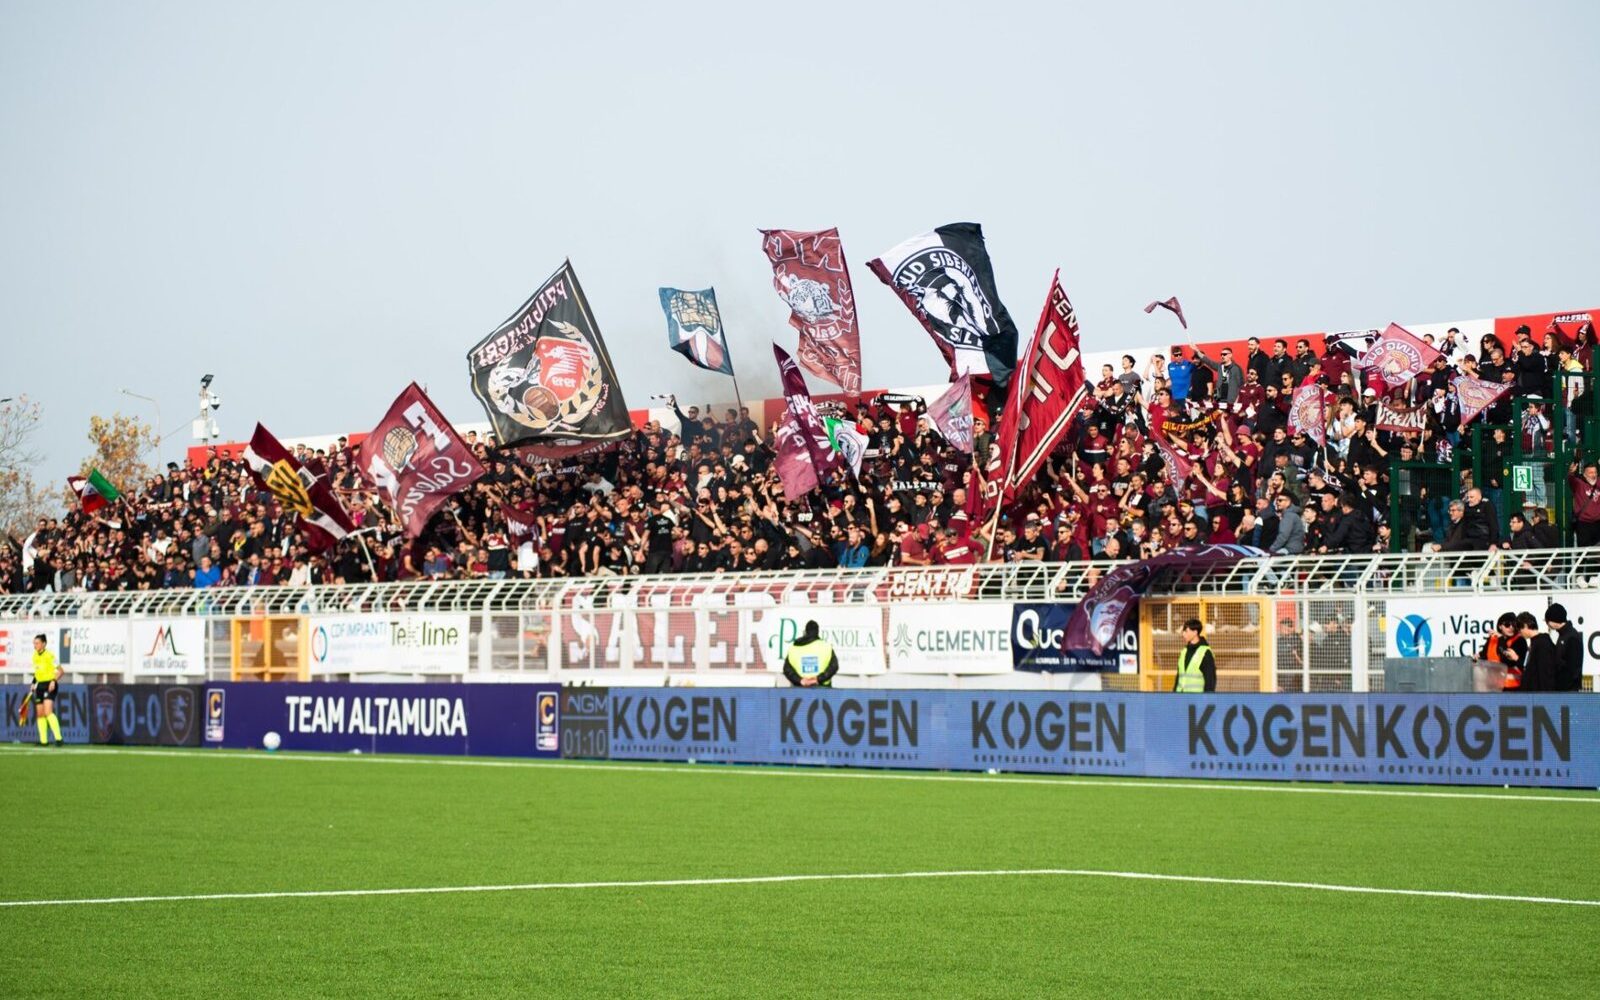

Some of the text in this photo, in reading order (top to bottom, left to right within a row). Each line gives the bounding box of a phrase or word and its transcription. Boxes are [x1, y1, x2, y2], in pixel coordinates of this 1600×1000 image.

[73, 627, 90, 639] BCC
[93, 643, 126, 656] MURGIA
[917, 630, 1008, 652] CLEMENTE
[286, 696, 468, 737] TEAM ALTAMURA
[612, 696, 737, 742] KOGEN
[780, 697, 918, 747] KOGEN
[971, 700, 1126, 753] KOGEN
[1188, 703, 1366, 758] KOGEN
[1376, 704, 1571, 761] KOGEN
